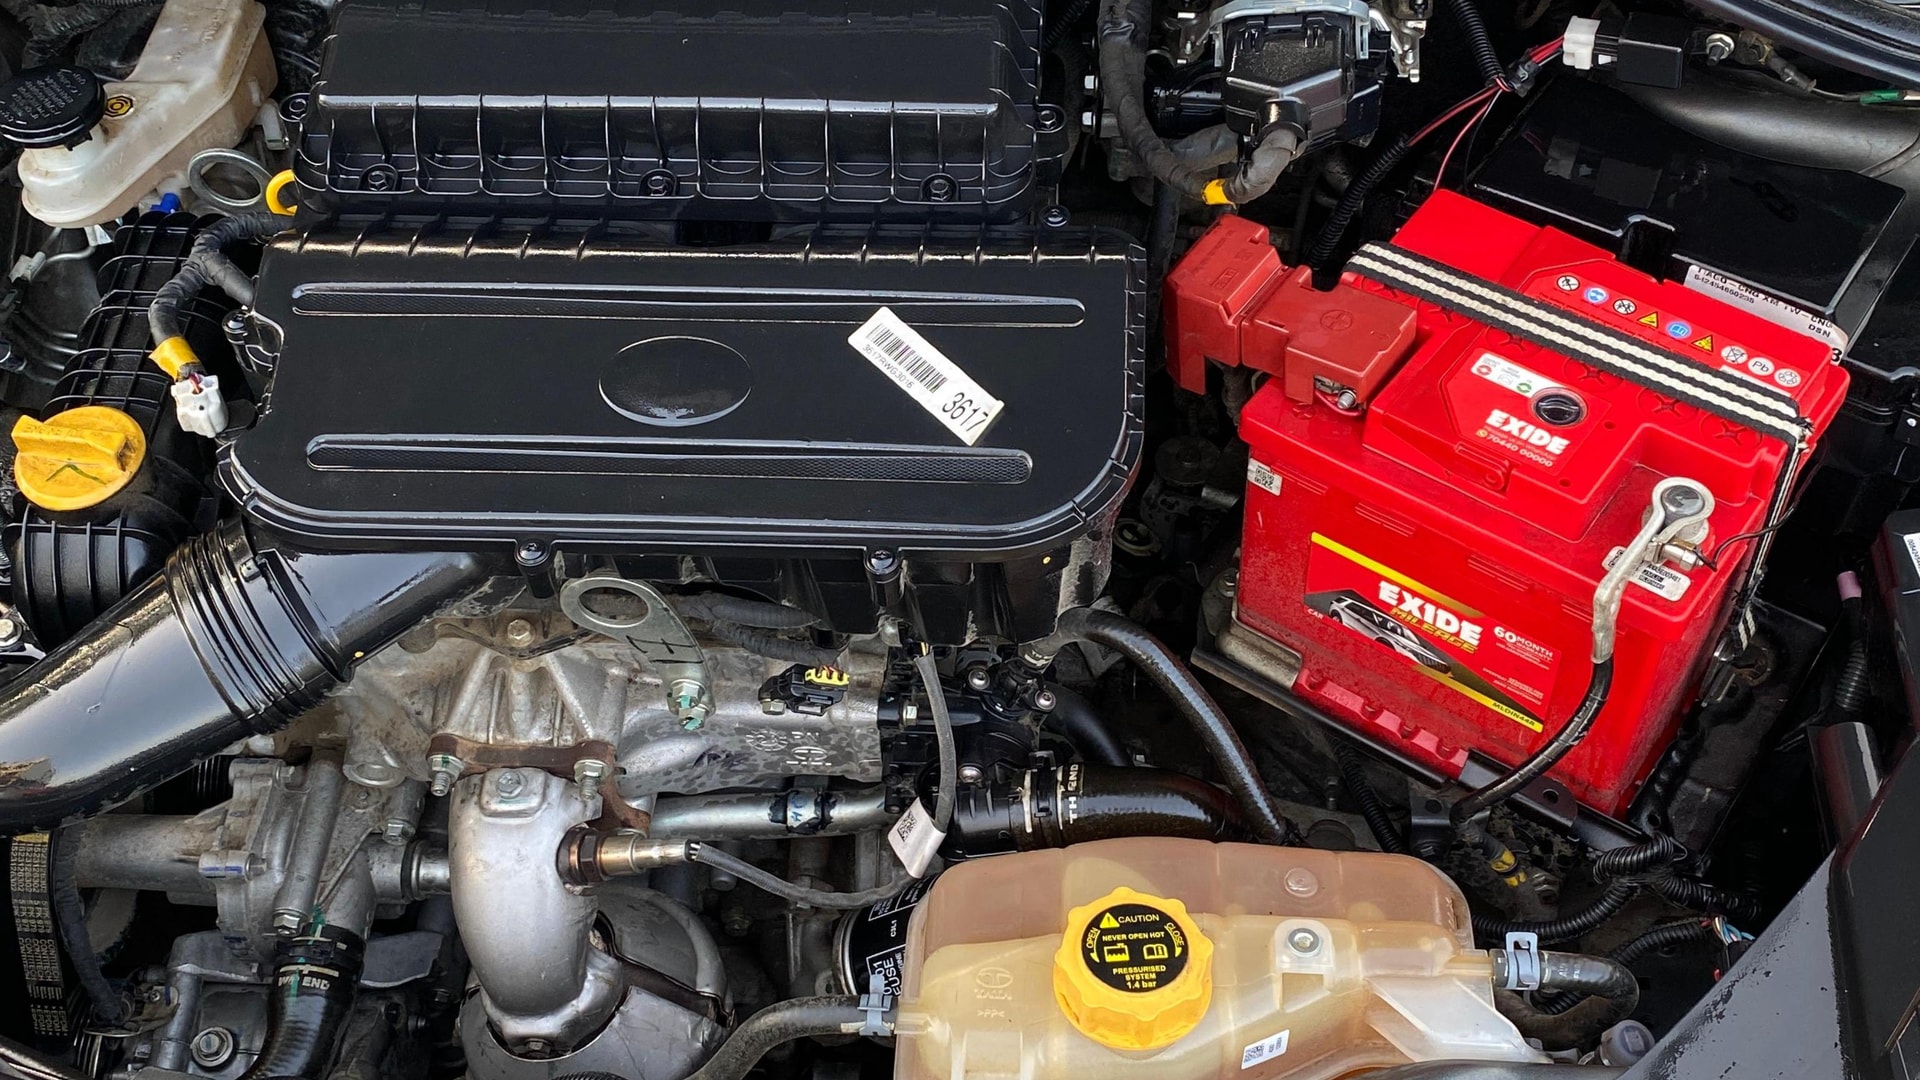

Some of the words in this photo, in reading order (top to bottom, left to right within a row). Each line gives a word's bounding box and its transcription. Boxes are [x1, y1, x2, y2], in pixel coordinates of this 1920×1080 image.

[1807, 323, 1832, 339] DSN
[1753, 359, 1770, 373] Pb
[942, 391, 989, 432] 3617
[1485, 409, 1571, 455] EXIDE
[1487, 434, 1519, 452] 70440
[1519, 446, 1553, 467] 00000
[1307, 608, 1324, 620] CAR
[1378, 580, 1484, 647] EXIDE
[1390, 607, 1479, 655] MILEAGE
[1118, 914, 1160, 924] CAUTION
[1086, 926, 1099, 949] OPEN
[1102, 933, 1127, 942] NEVER
[1128, 932, 1149, 940] OPEN
[1149, 931, 1165, 939] HOT
[1166, 922, 1185, 946] CLOSE
[25, 938, 37, 980] CONTITECH
[32, 938, 44, 980] CONTITECH
[40, 939, 52, 981] CONTITECH
[48, 939, 60, 982] CONTITECH
[1112, 964, 1167, 976] PRESSURISED
[301, 976, 331, 990] END
[1125, 972, 1157, 981] SYSTEM
[1126, 980, 1140, 989] 1.4
[1142, 980, 1157, 988] bar
